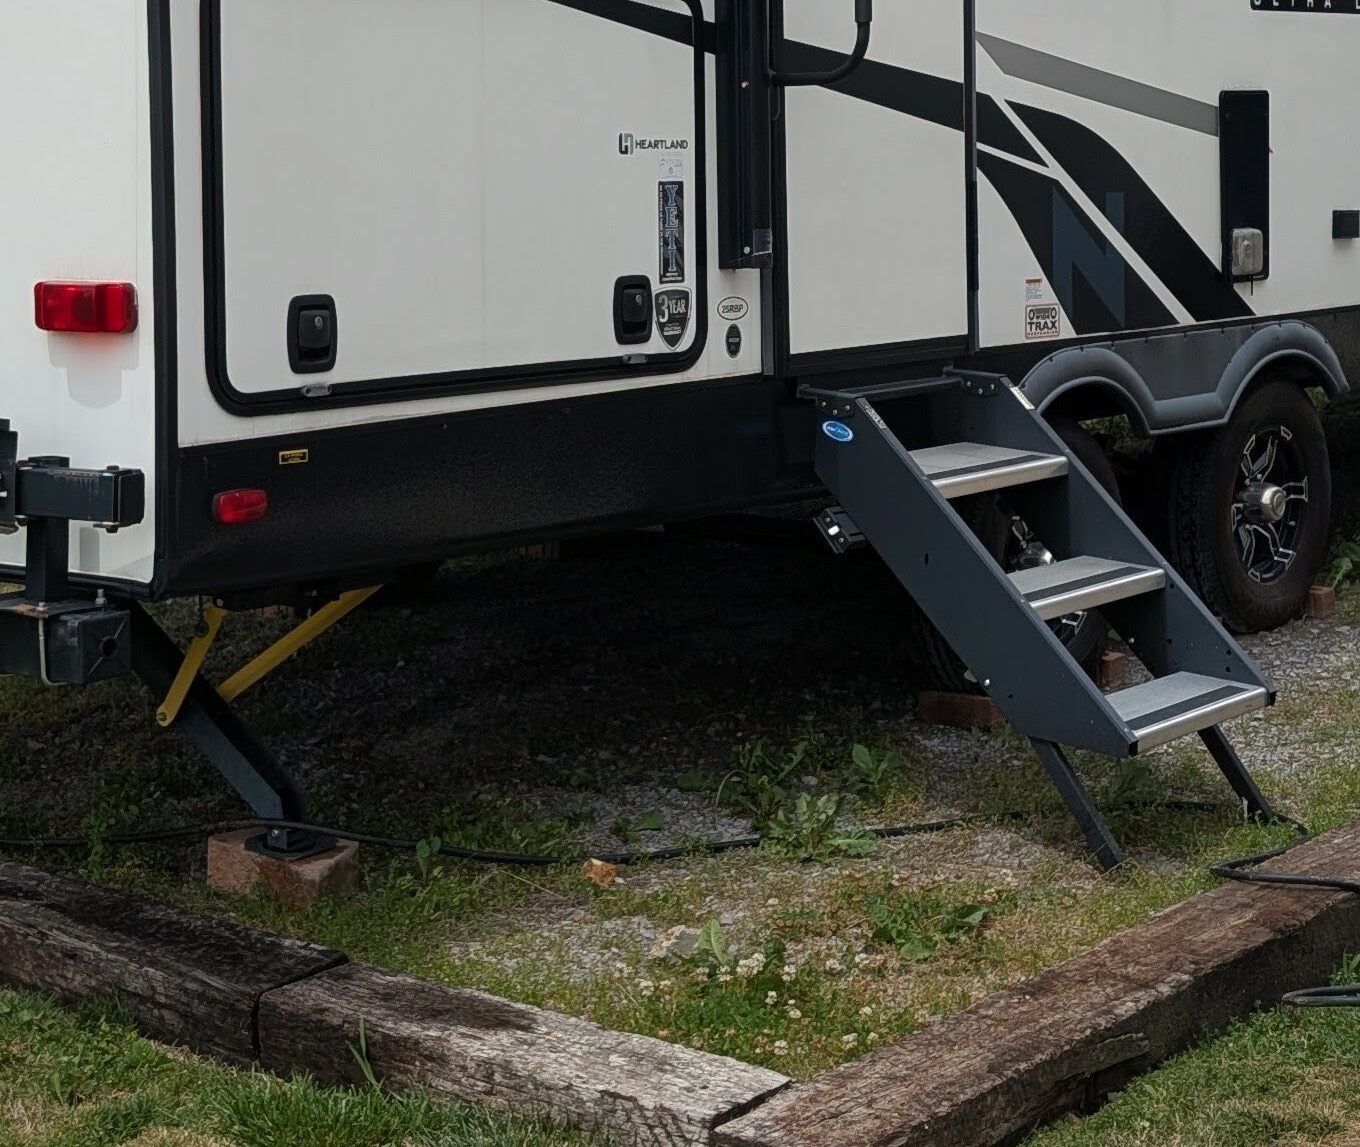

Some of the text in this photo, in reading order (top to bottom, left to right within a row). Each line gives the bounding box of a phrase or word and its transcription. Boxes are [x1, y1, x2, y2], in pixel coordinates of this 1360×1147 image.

[635, 139, 689, 150] HEARTLAND
[664, 184, 679, 272] YETI
[658, 294, 687, 322] 3 YEAR
[1027, 320, 1058, 332] TRAX
